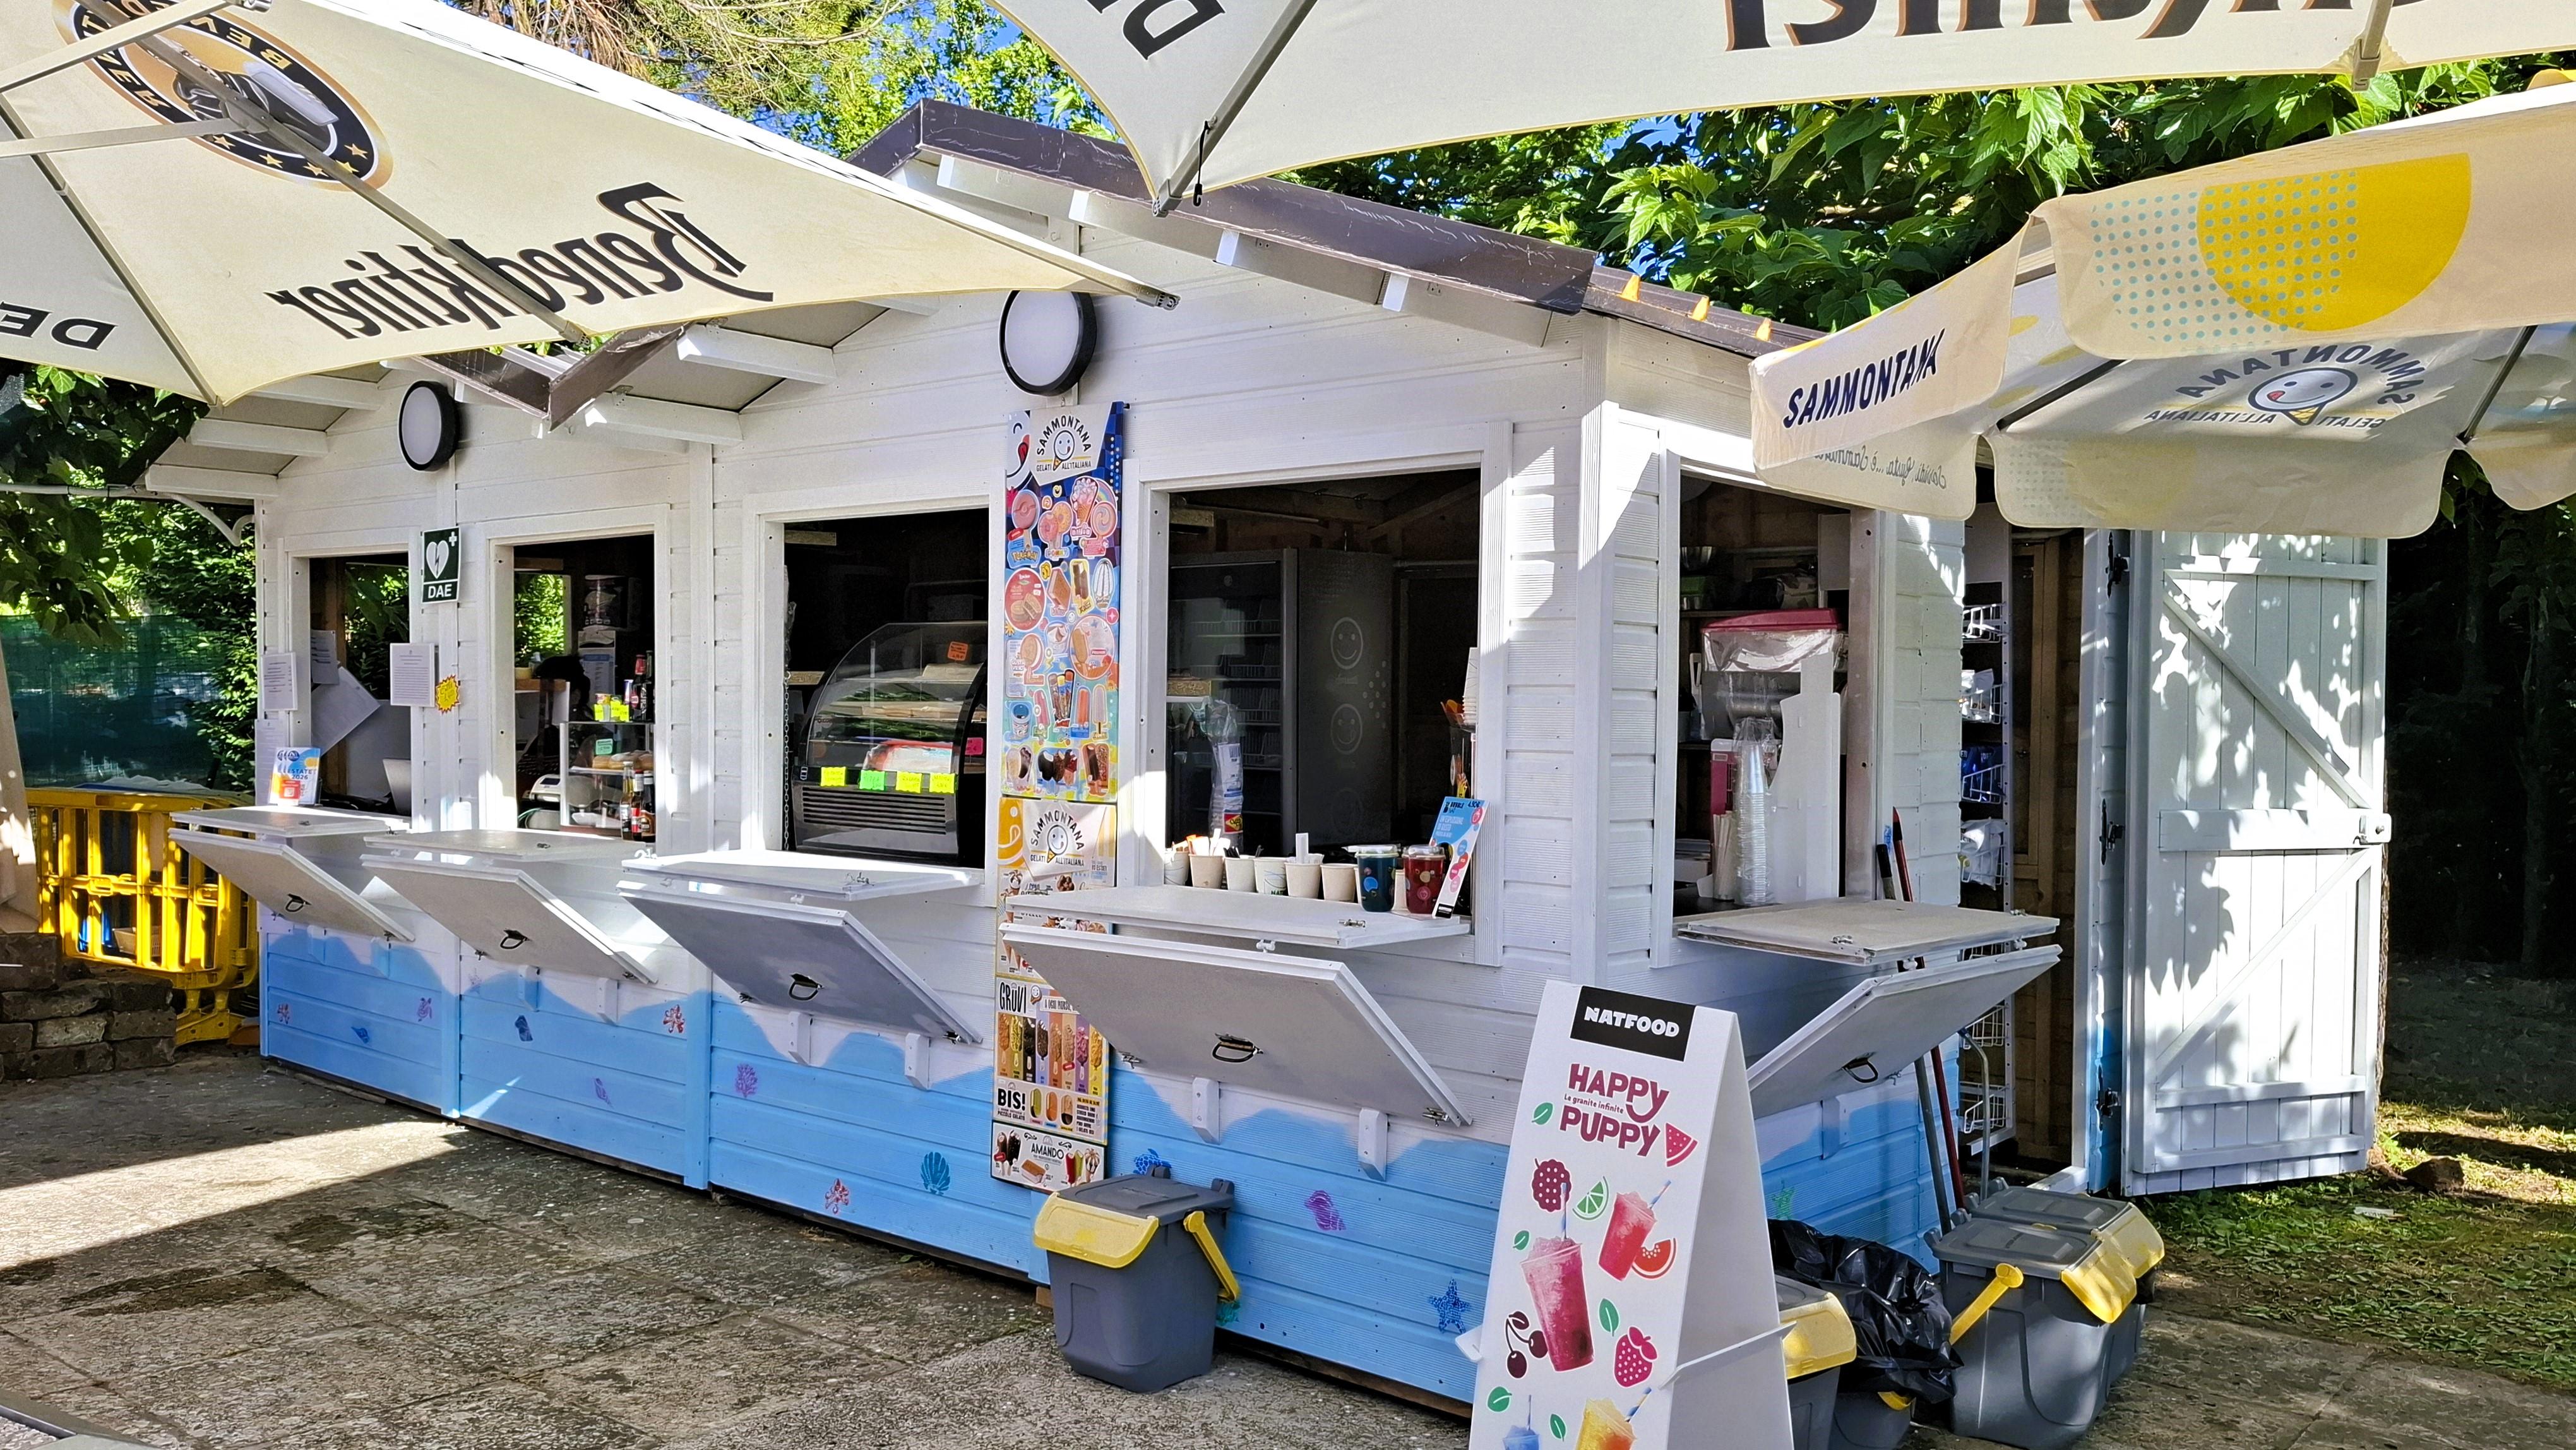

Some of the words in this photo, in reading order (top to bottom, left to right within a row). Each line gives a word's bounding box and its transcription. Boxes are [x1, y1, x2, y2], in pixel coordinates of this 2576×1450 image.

[1036, 414, 1092, 456] SAMMONTANA
[1036, 464, 1052, 472] GELATI
[428, 583, 452, 599] DAE
[1030, 810, 1085, 851] SAMMONTANA
[1030, 854, 1046, 863] GELATI
[1583, 1005, 1680, 1037] NATFOOD
[998, 1088, 1026, 1111] BIS!
[1564, 1093, 1571, 1101] Le
[1572, 1095, 1597, 1108] granite
[1598, 1100, 1625, 1114] infinite
[1568, 1063, 1670, 1123] HAPPY
[1559, 1105, 1661, 1157] PUPPY
[1031, 1142, 1064, 1159] AMANDO
